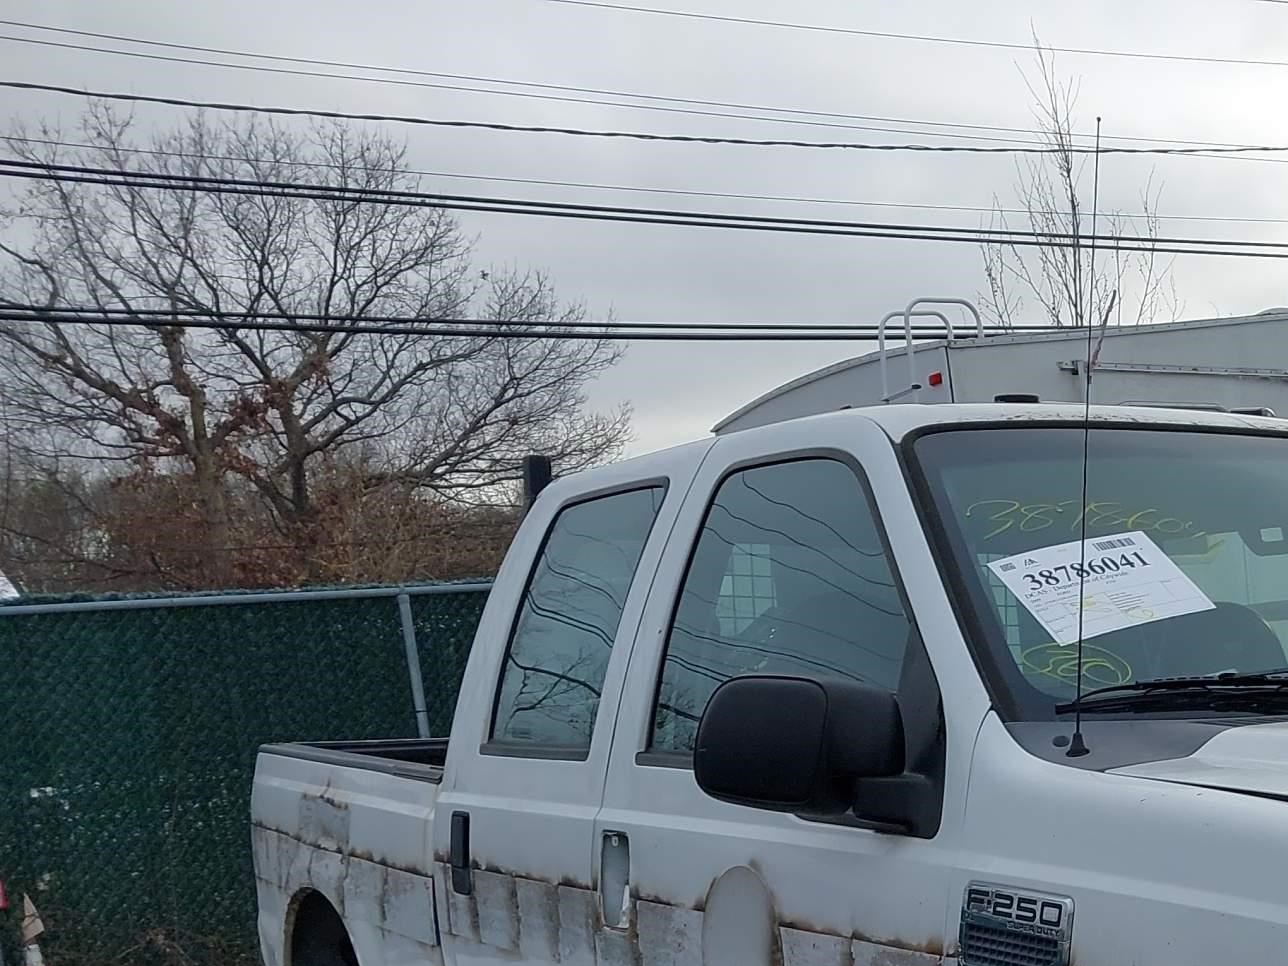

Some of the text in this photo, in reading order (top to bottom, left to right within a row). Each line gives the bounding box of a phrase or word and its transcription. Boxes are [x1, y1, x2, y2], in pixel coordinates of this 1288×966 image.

[1022, 551, 1151, 591] 38786041
[967, 888, 1063, 928] F-250
[1006, 920, 1062, 938] SUPER DUTY
